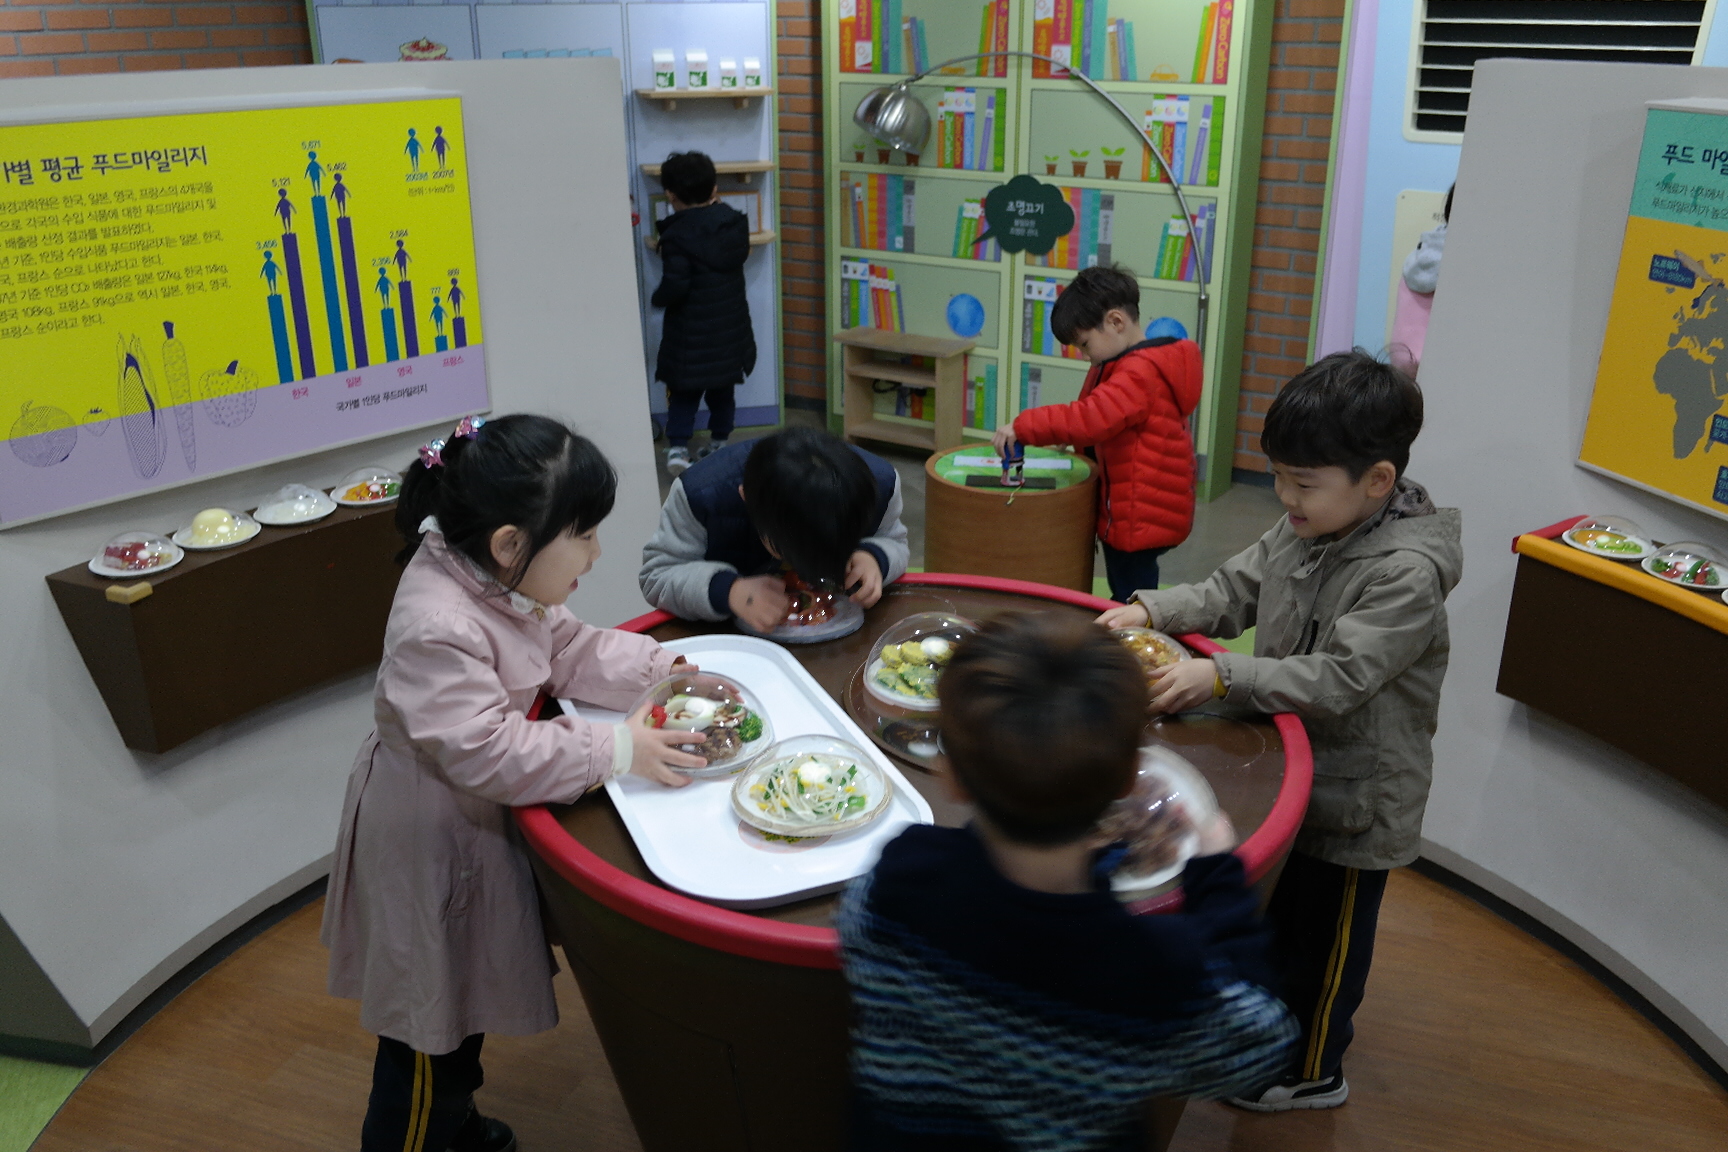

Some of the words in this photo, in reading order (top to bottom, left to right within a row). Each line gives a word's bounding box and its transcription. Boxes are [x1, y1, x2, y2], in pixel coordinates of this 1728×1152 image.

[1219, 17, 1230, 41] Zero
[1215, 42, 1228, 79] Carbon
[1662, 144, 1695, 166] 푸드
[41, 156, 84, 183] 평균
[91, 145, 207, 176] 푸드마일리지
[63, 212, 84, 226] 수입
[146, 199, 204, 215] 푸드마일리지
[18, 270, 50, 284] 프랑스
[59, 299, 90, 313] 프랑스
[1, 325, 34, 339] 프랑스
[443, 355, 464, 367] 프랑스
[397, 365, 413, 377] 영국
[345, 376, 362, 388] 일본
[292, 387, 309, 400] 한국
[336, 400, 360, 412] 국가별
[362, 394, 381, 406] 1인당
[383, 383, 428, 401] 푸드마일리지
